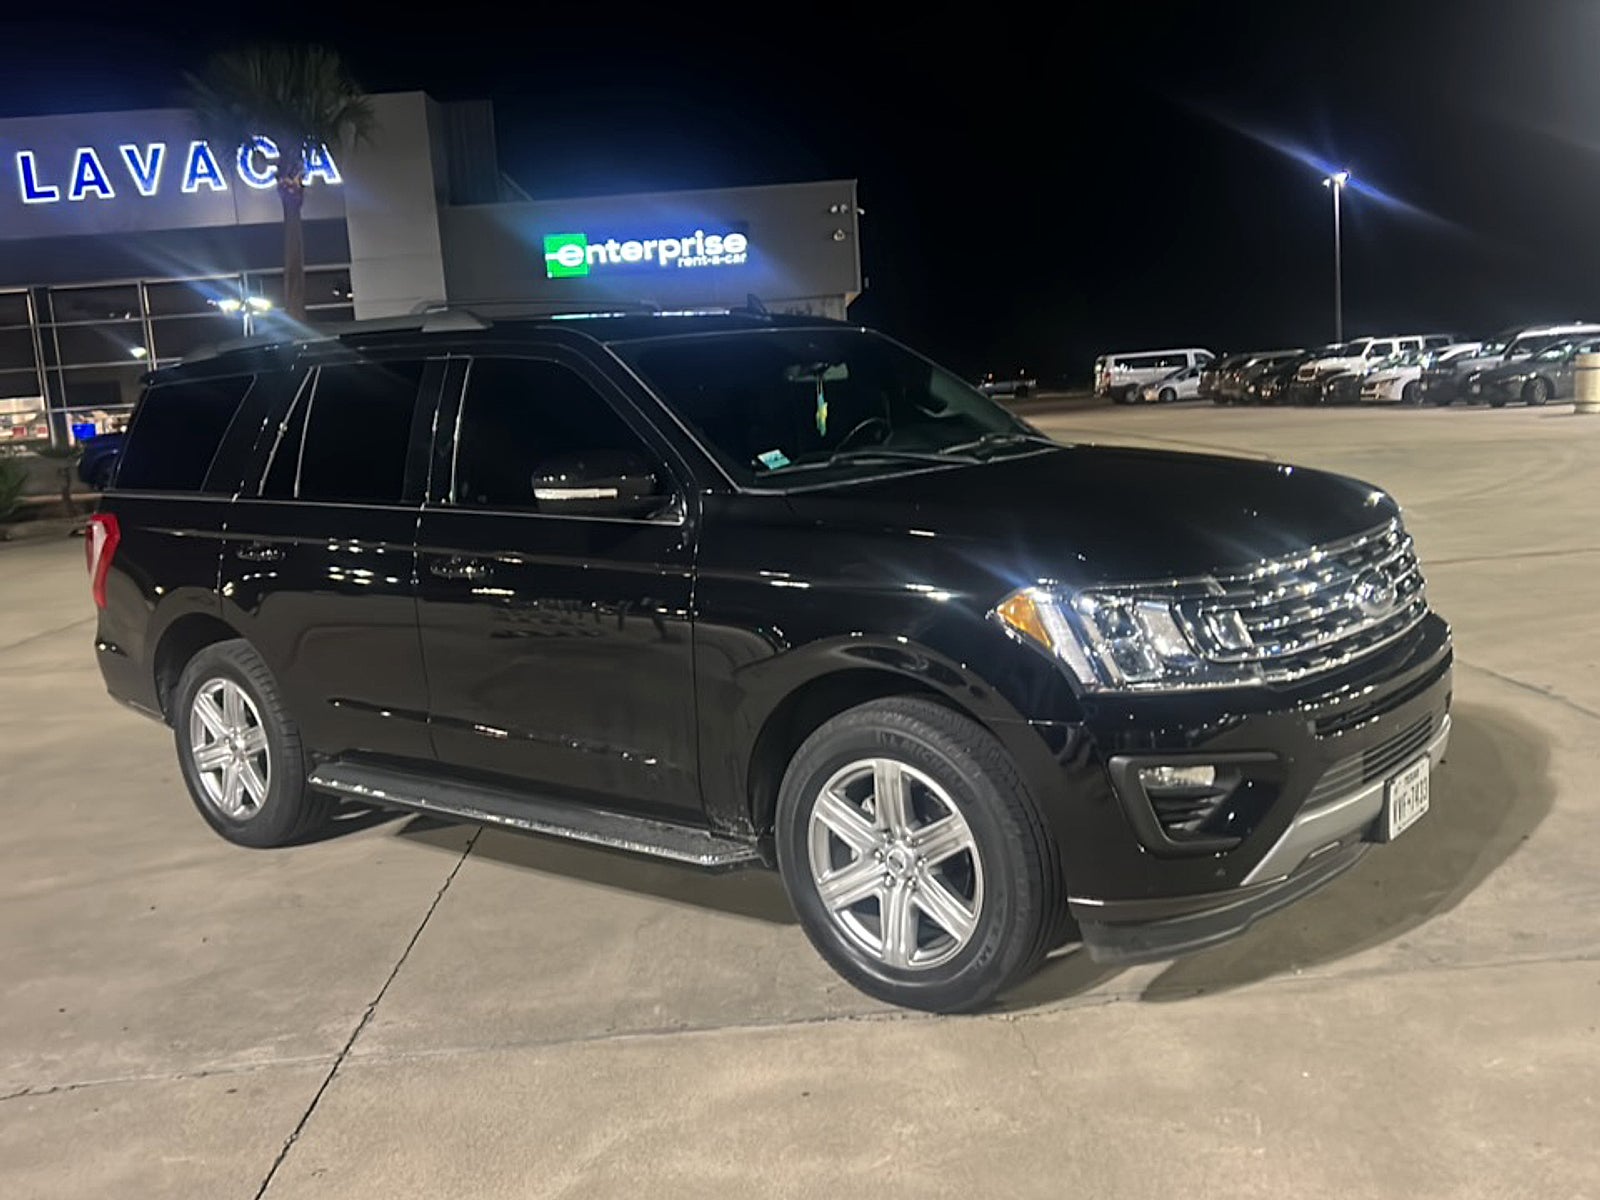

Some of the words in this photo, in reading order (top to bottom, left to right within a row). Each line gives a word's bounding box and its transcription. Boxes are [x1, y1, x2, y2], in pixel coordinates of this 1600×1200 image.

[16, 134, 343, 204] LAVACA
[545, 229, 748, 267] enterprise
[677, 252, 748, 268] rent-a-car
